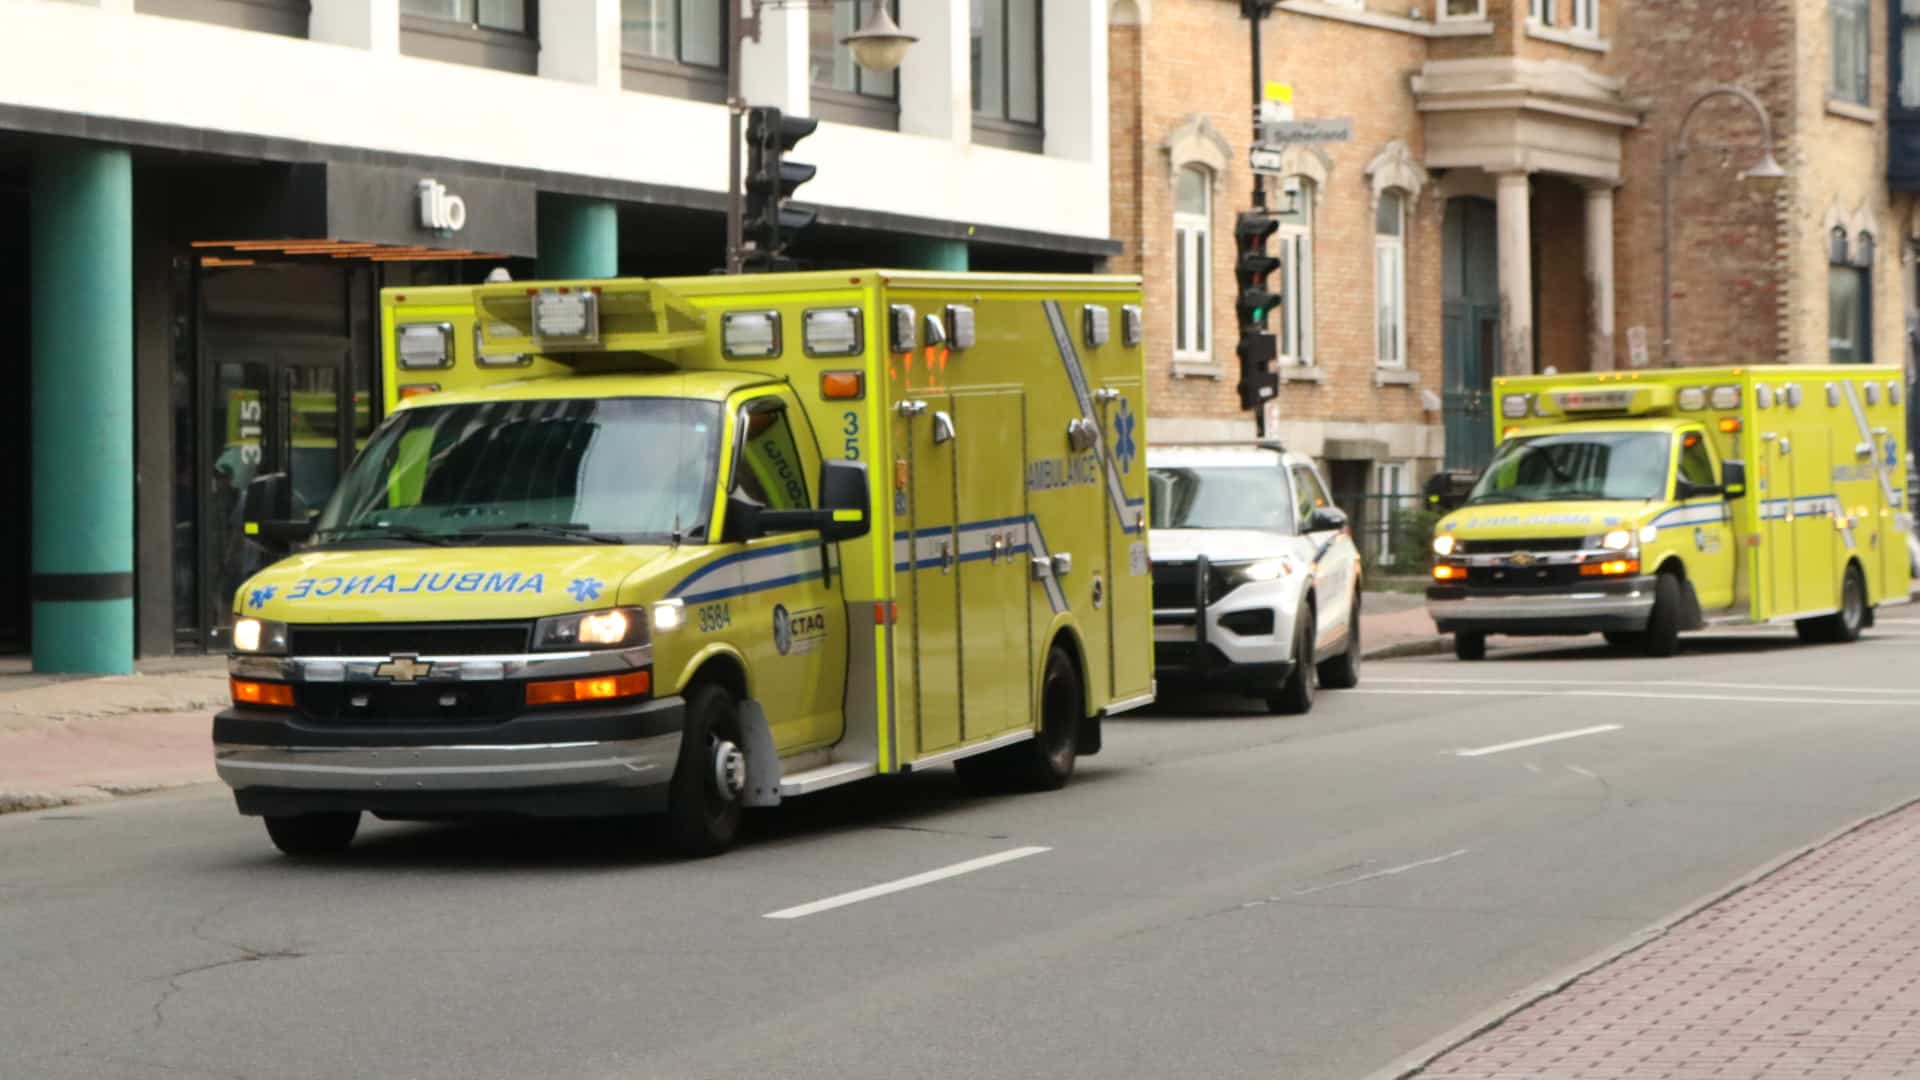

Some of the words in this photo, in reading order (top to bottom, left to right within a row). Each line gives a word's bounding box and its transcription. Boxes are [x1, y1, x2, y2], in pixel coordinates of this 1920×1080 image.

[240, 400, 262, 465] 315
[698, 602, 731, 632] 3584
[791, 613, 824, 635] CTAQ
